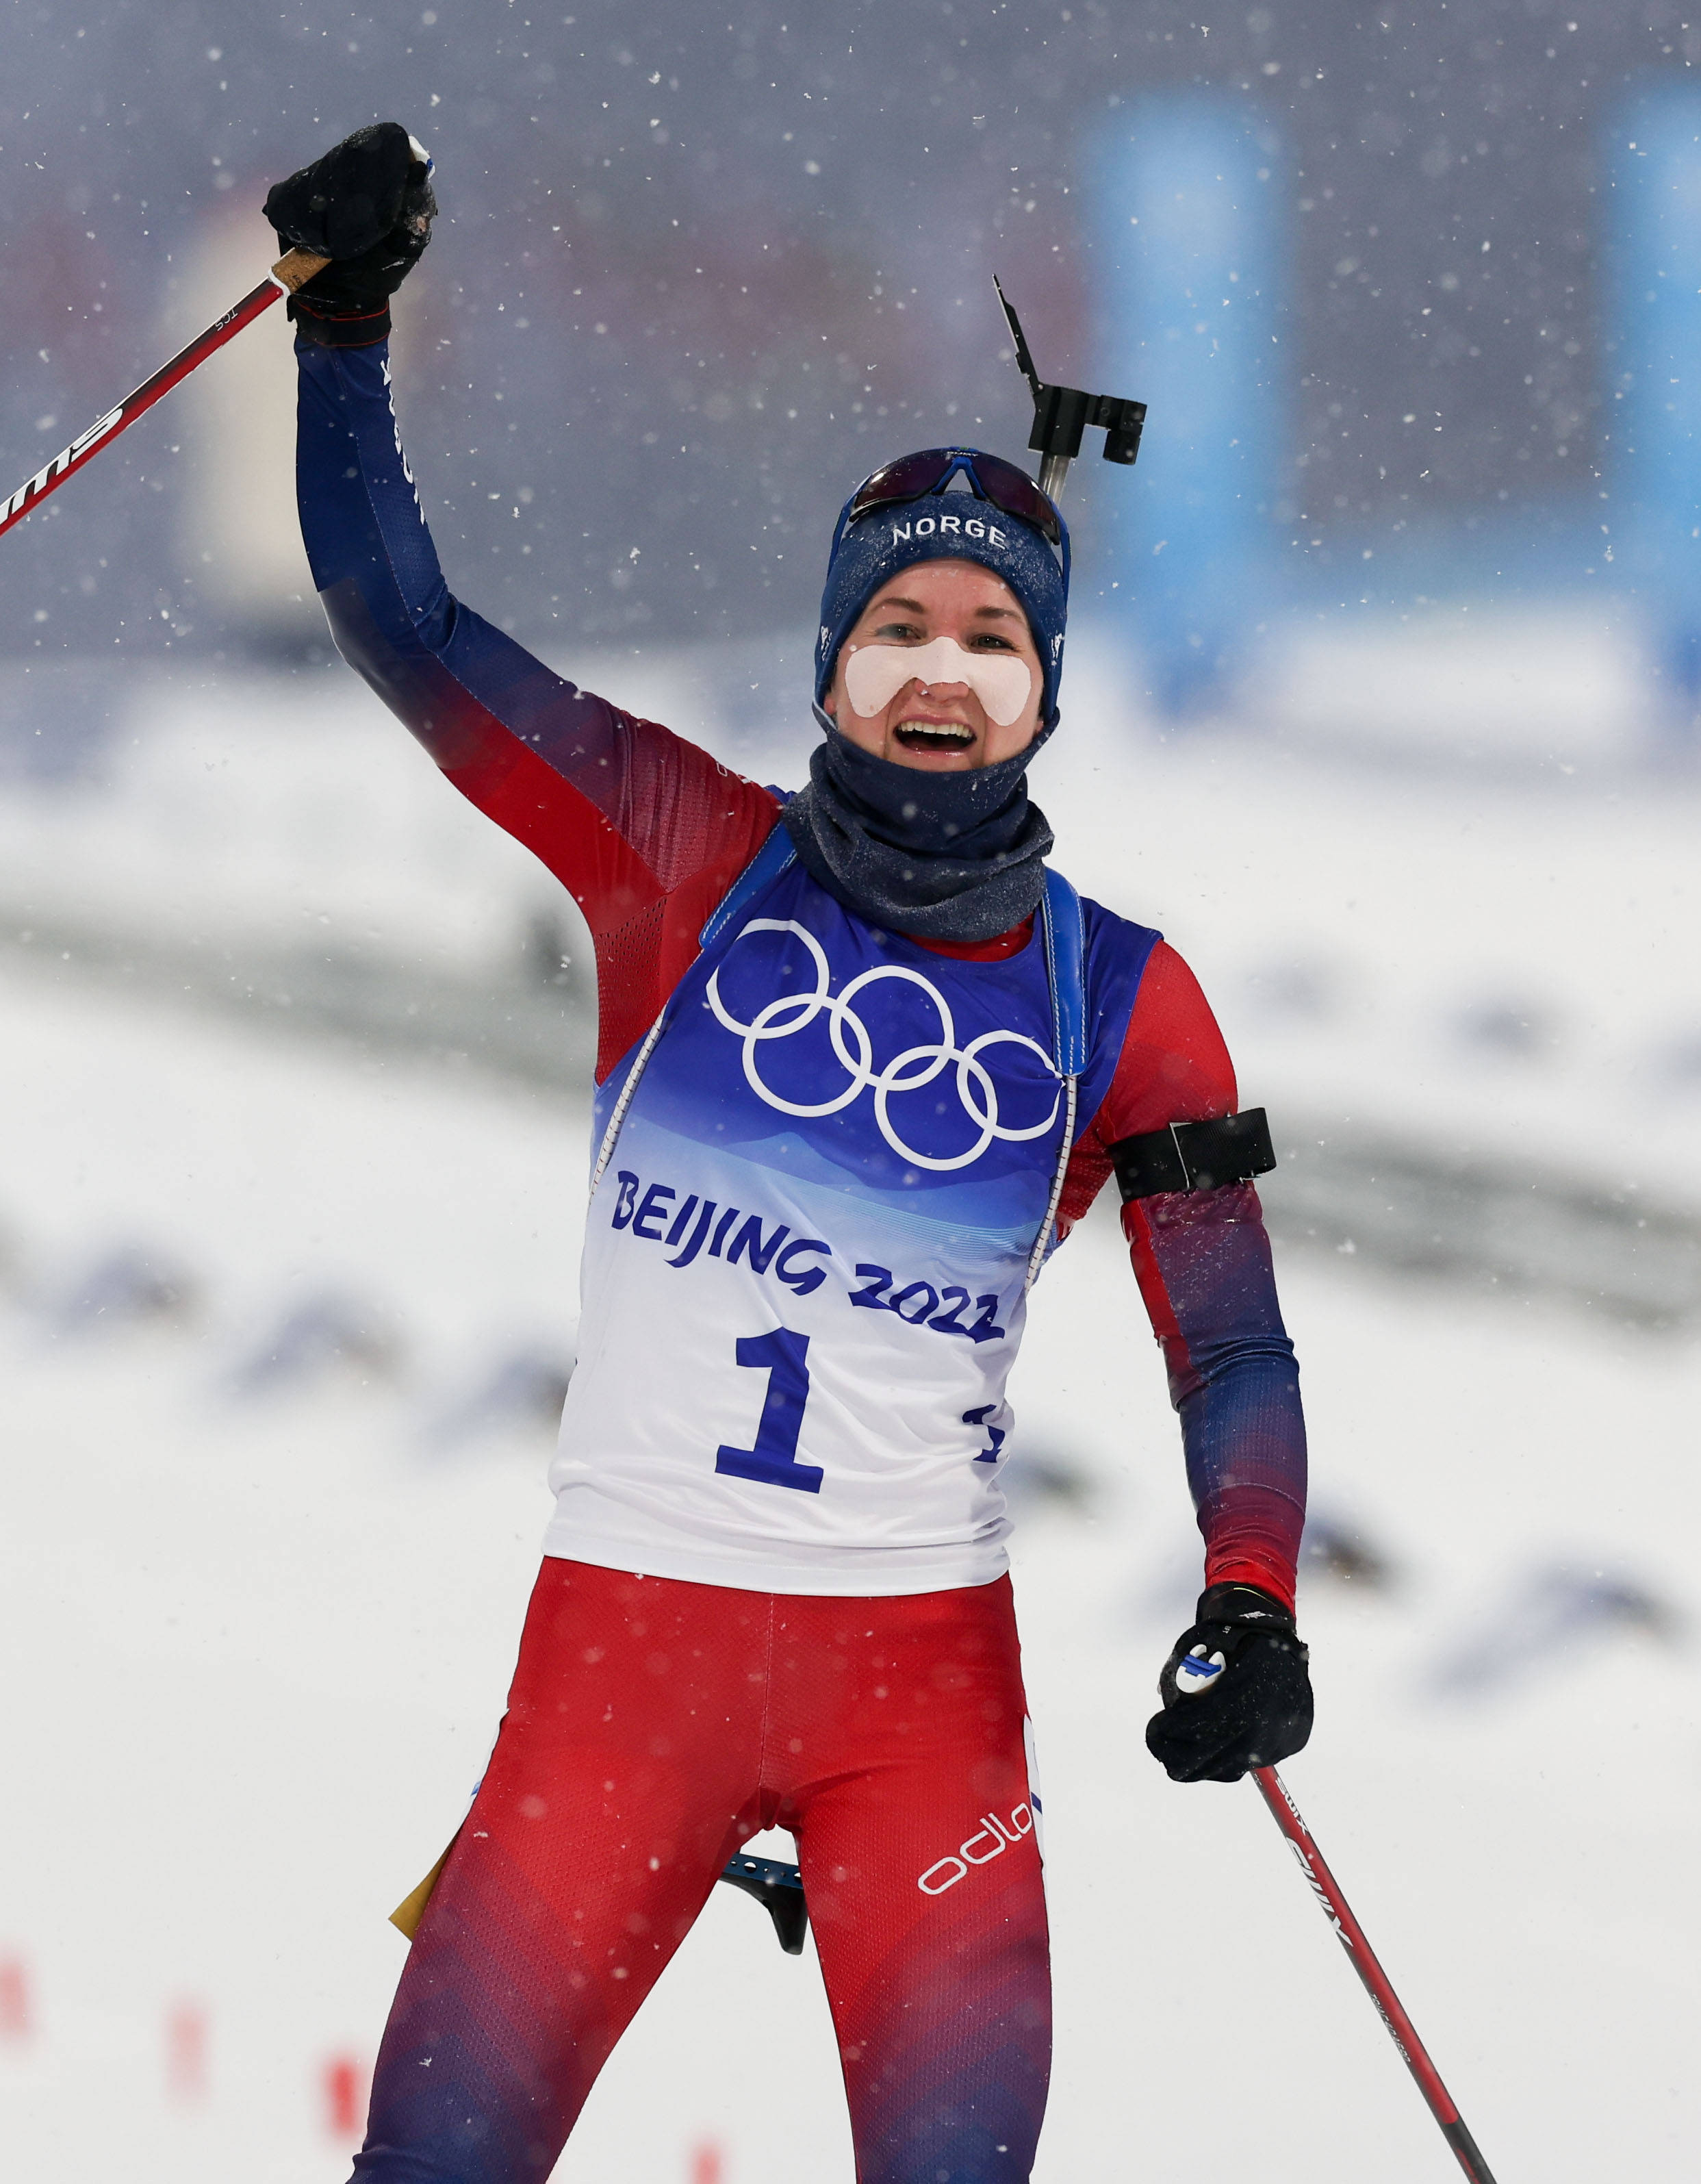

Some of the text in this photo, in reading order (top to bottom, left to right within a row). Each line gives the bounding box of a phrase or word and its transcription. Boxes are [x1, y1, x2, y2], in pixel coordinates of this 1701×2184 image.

[893, 516, 1006, 550] NORGE
[611, 1170, 1005, 1344] BEIJING 2022
[715, 1326, 824, 1494] 1
[962, 1404, 1006, 1463] 1
[918, 1803, 1032, 1895] odlo
